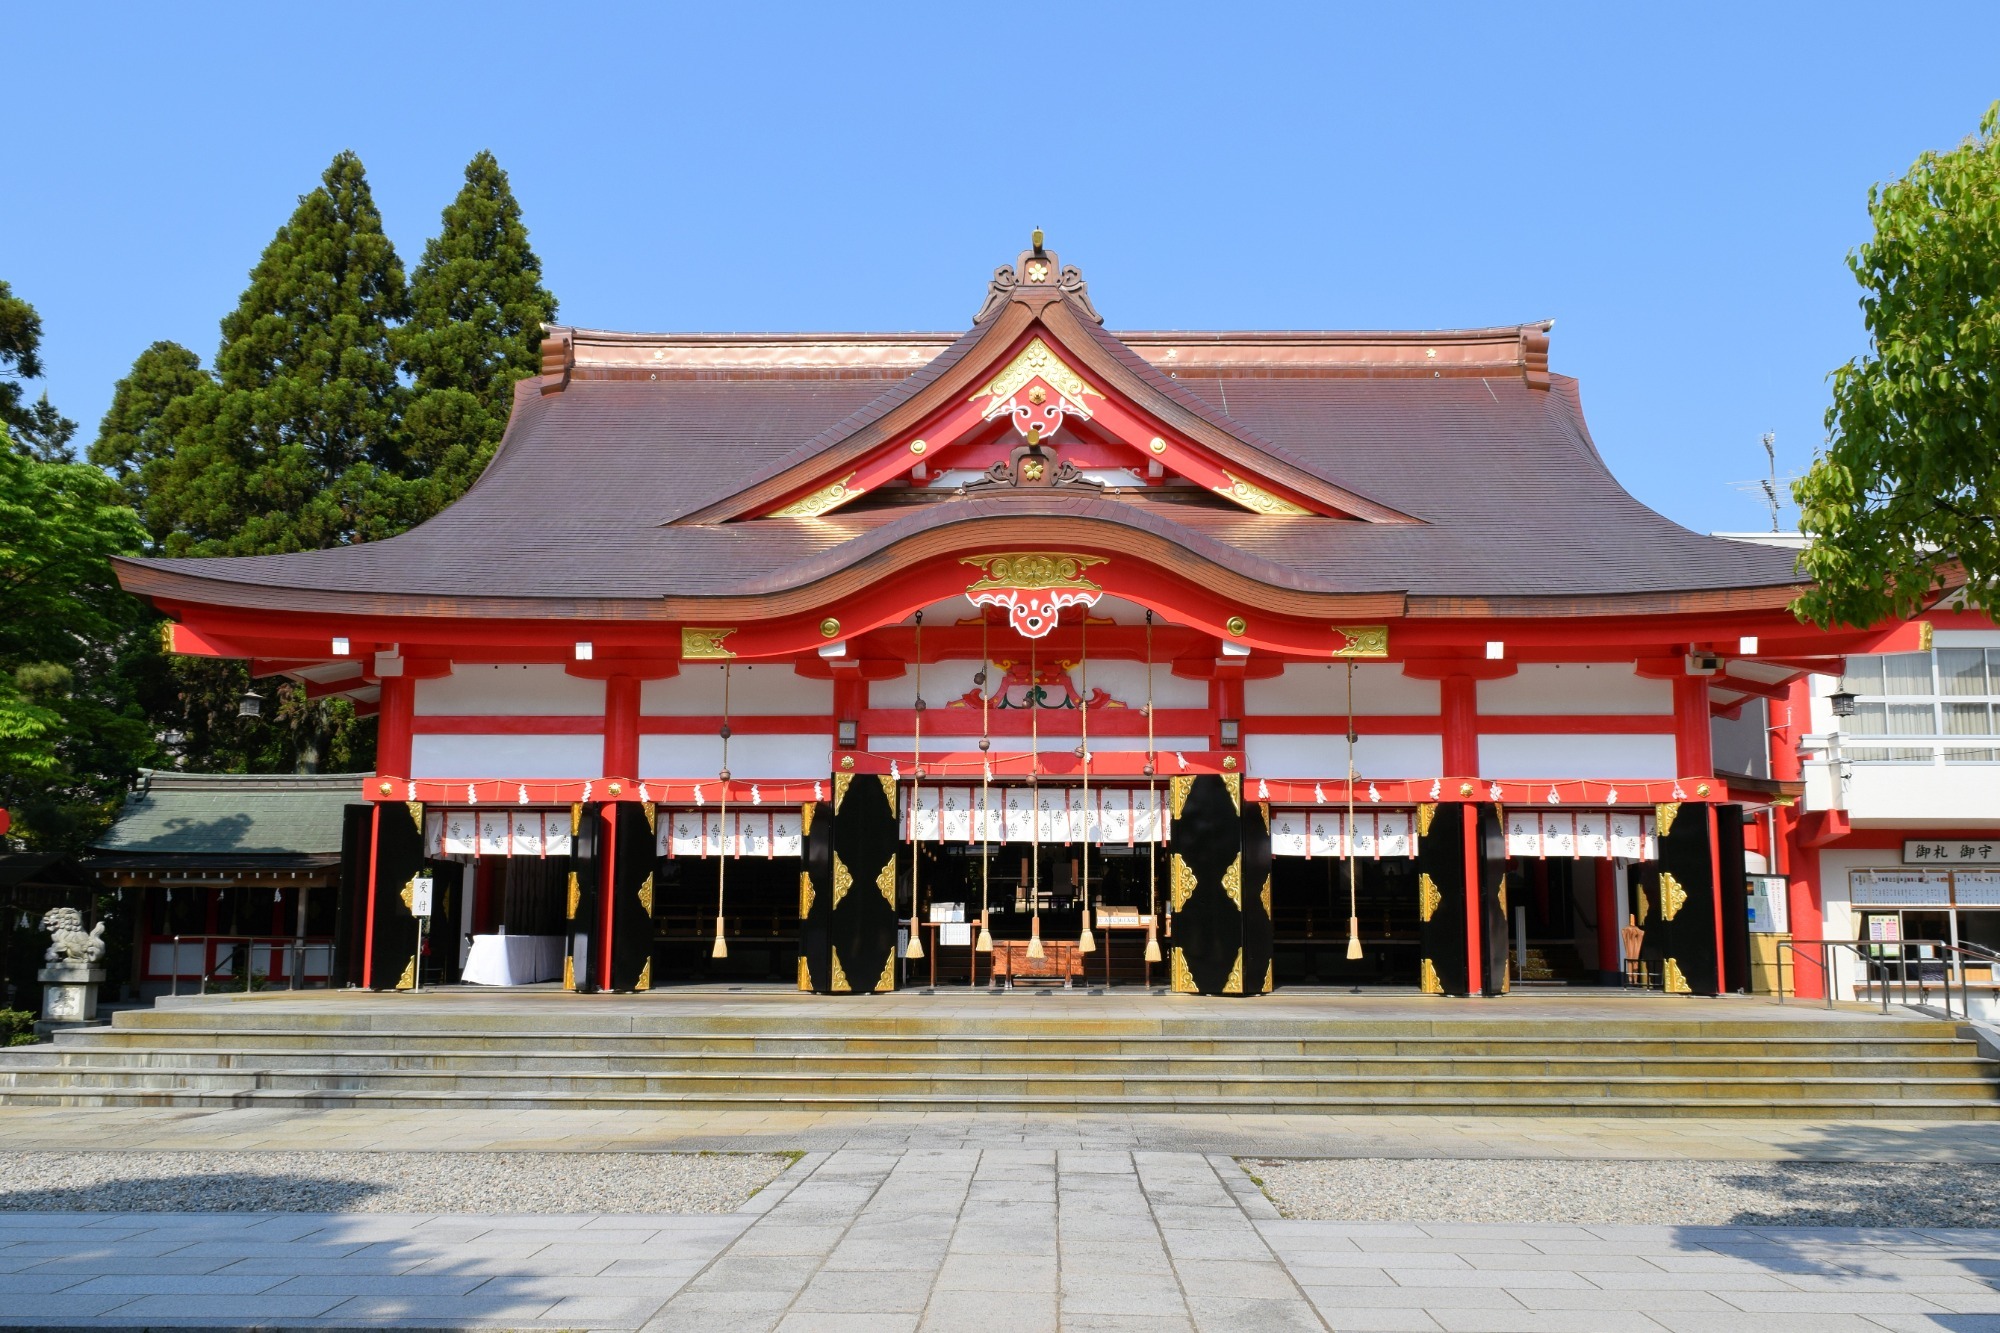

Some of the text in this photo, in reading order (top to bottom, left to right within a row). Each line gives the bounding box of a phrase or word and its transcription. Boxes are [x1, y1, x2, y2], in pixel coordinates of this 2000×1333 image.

[1915, 844, 1993, 859] 御札 御守
[419, 881, 428, 911] 受付
